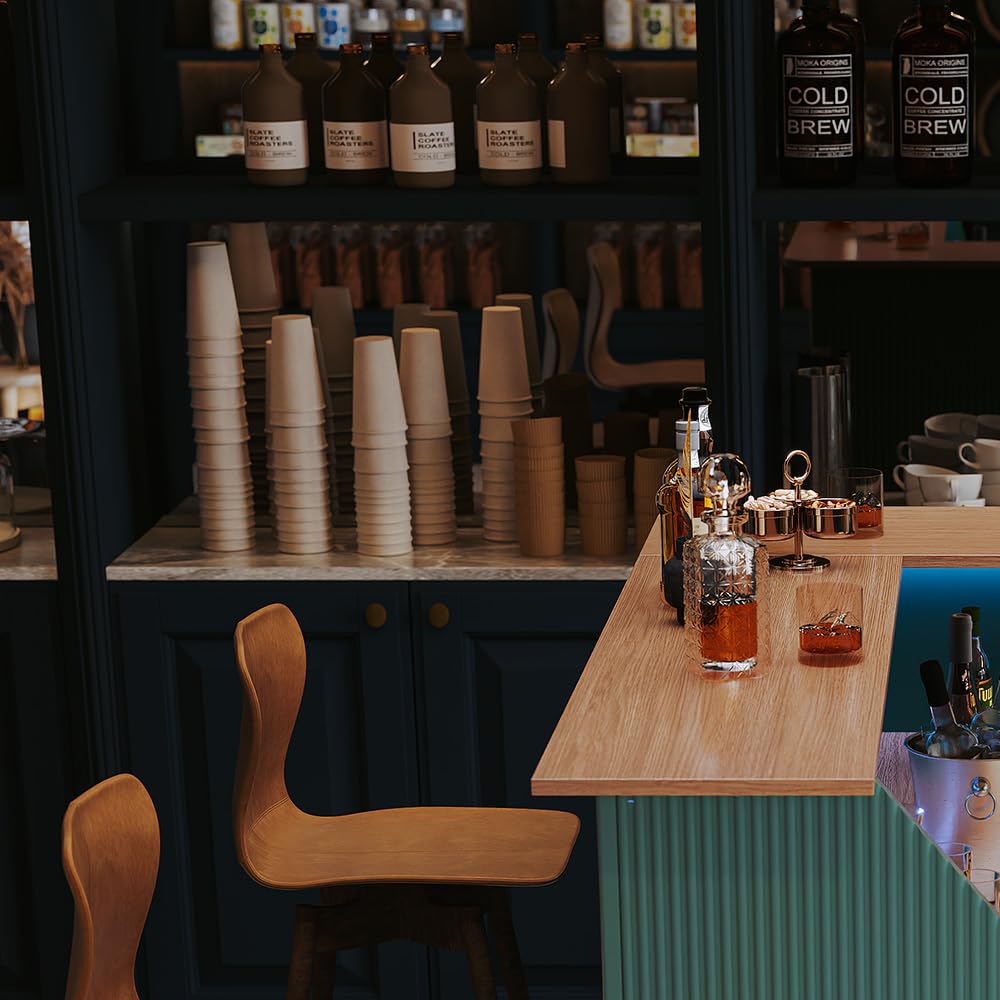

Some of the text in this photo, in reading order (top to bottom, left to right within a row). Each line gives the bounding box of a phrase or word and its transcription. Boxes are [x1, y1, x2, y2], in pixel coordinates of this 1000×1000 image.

[788, 87, 848, 105] COLD
[905, 87, 965, 105] COLD
[787, 119, 851, 135] BREW
[904, 119, 967, 135] BREW
